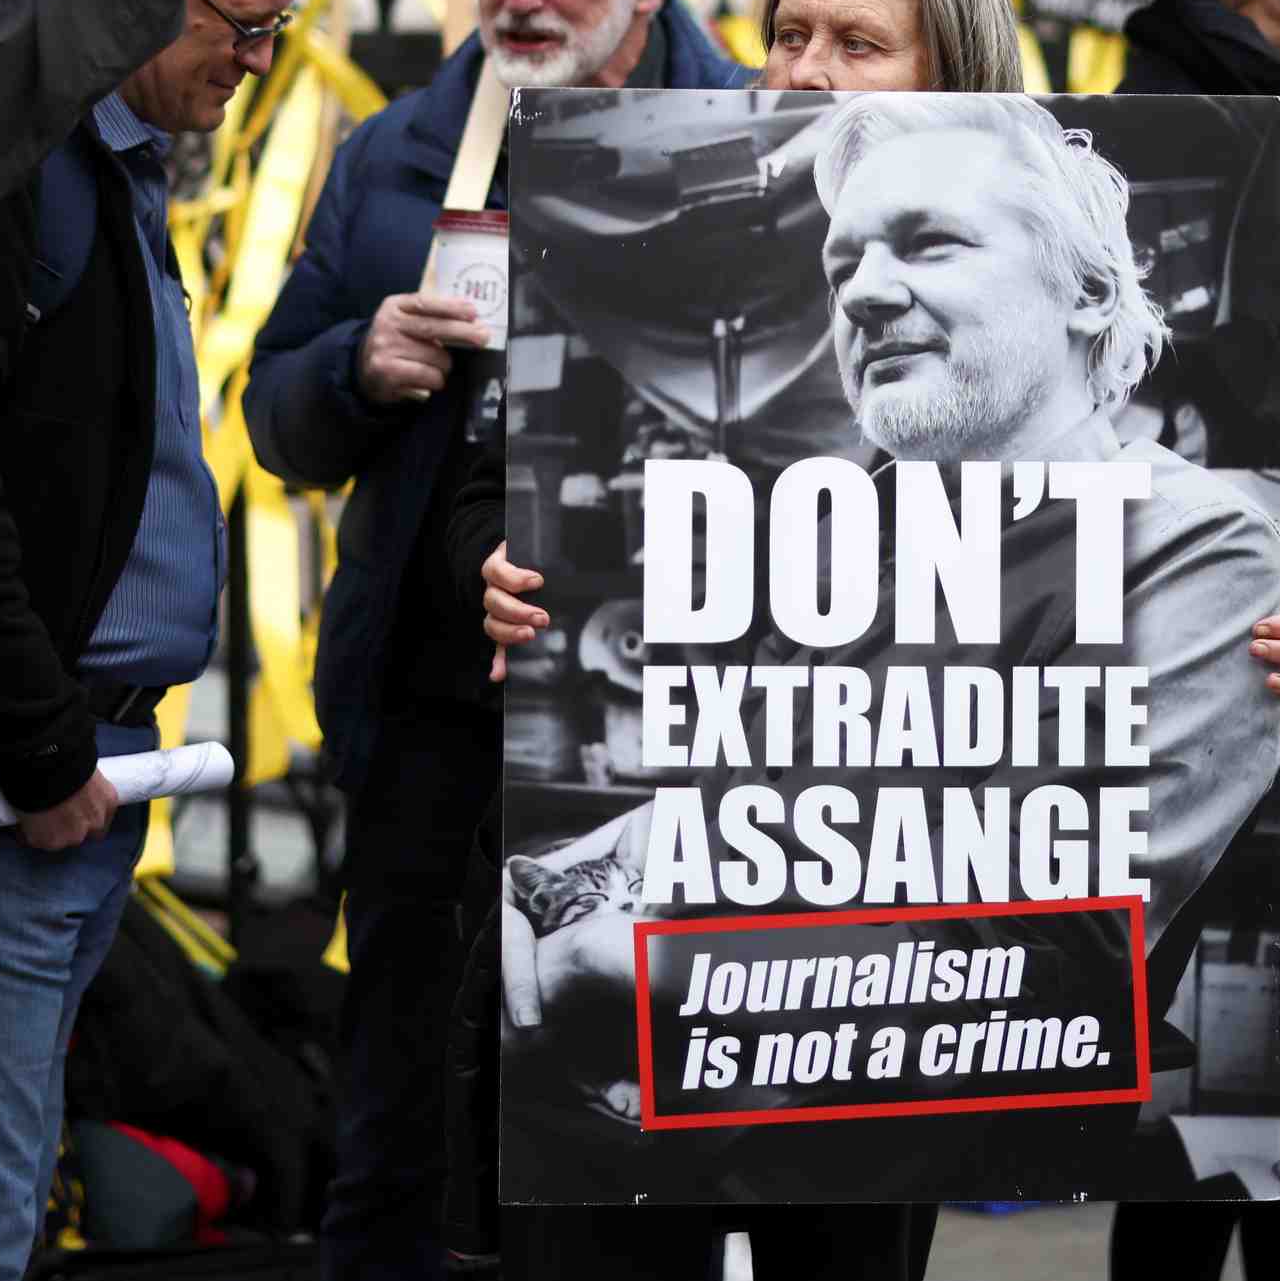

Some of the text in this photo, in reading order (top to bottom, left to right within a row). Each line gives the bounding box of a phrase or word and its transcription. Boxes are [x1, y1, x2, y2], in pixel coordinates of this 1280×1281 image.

[642, 455, 1152, 646] DON'T
[641, 665, 1151, 768] EXTRADITE
[641, 784, 1152, 906] ASSANGE
[679, 940, 1026, 1018] Journalism
[681, 1008, 1112, 1091] is not a crime.
